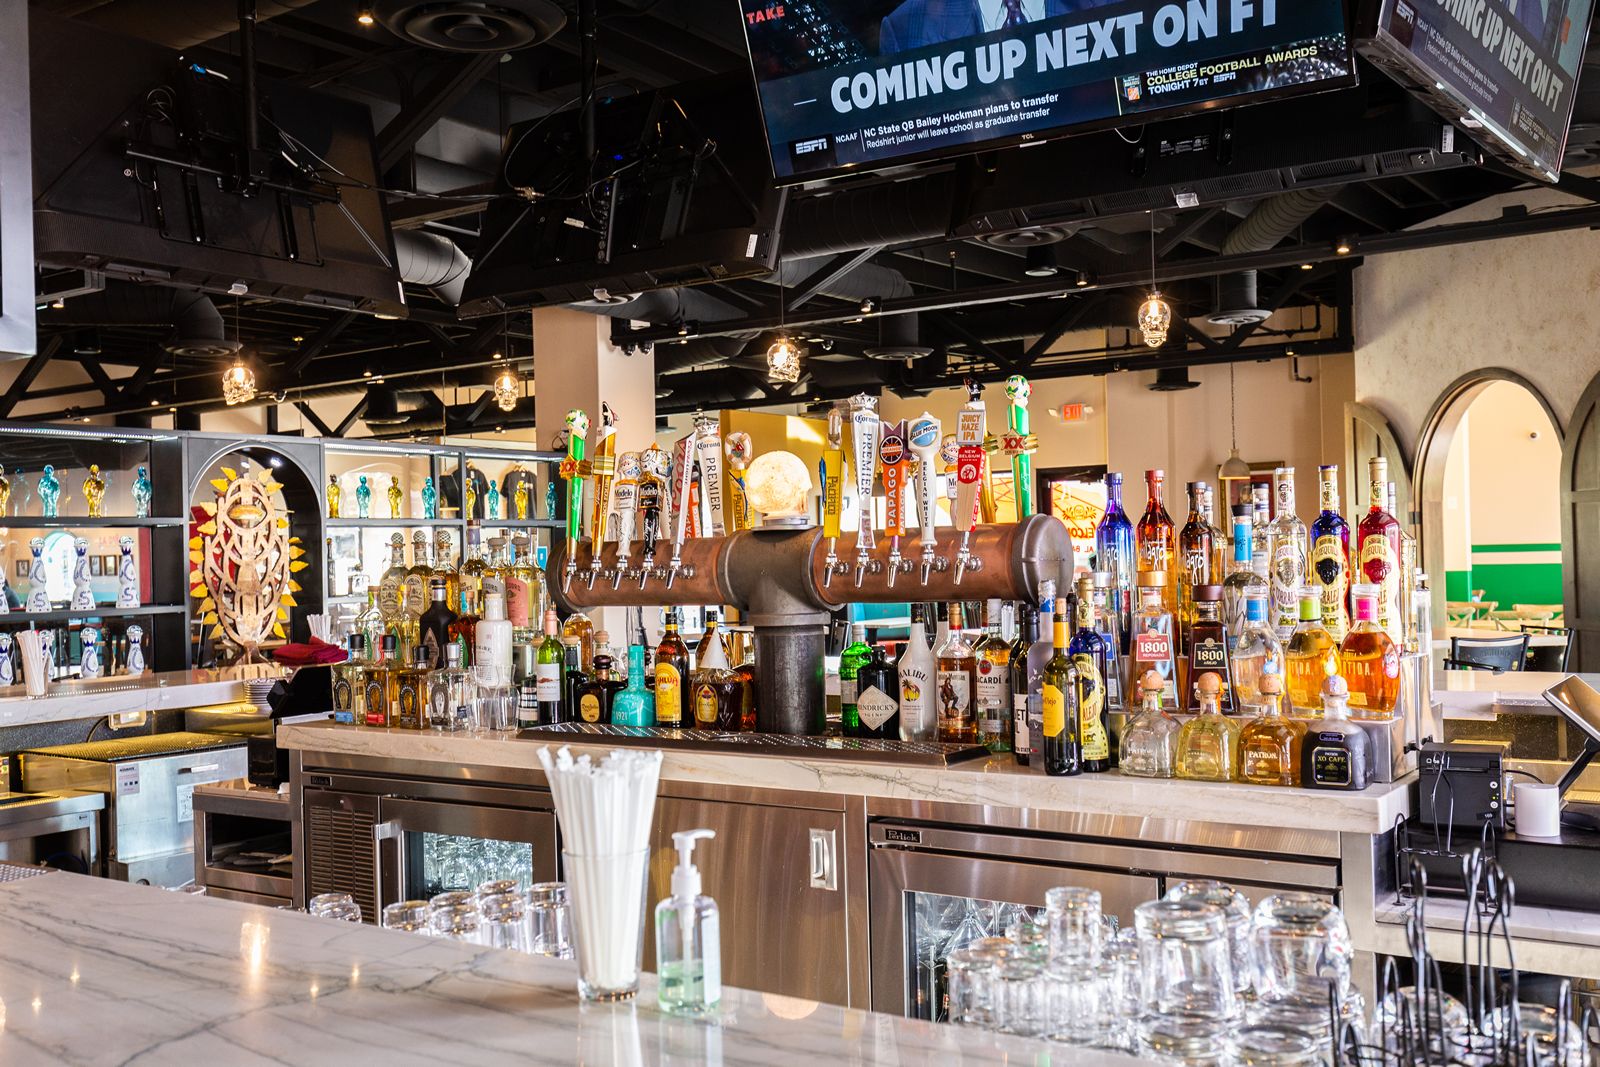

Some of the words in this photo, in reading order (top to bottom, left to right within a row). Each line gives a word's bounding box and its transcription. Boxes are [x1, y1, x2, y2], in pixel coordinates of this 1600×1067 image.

[746, 5, 785, 25] TAKE
[830, 50, 968, 114] COMING
[976, 39, 1027, 84] UP
[1035, 11, 1144, 73] NEXT
[1152, 0, 1218, 47] ON
[1481, 7, 1504, 53] UP
[1499, 26, 1535, 85] NEXT
[1530, 58, 1551, 101] ON
[1546, 73, 1564, 113] FT
[1146, 69, 1158, 77] THE
[1159, 66, 1176, 75] HOME
[1176, 62, 1198, 72] DEPOT
[1147, 69, 1198, 87] COLLEGE
[1200, 57, 1261, 77] FOOTBALL
[1264, 46, 1318, 64] AWARDS
[1148, 79, 1191, 95] TONIGHT
[1213, 72, 1236, 84] ESPN
[864, 127, 878, 138] NC
[878, 124, 901, 136] State
[902, 119, 915, 131] QB
[916, 114, 941, 128] Bailey
[943, 108, 984, 123] Hockman
[985, 103, 1009, 116] plans
[1010, 101, 1021, 110] to
[1022, 93, 1059, 108] transfer
[866, 135, 896, 149] Redshirt
[896, 132, 916, 146] junior
[917, 129, 929, 141] will
[930, 127, 949, 138] leave
[949, 121, 973, 134] school
[974, 121, 984, 129] as
[984, 113, 1019, 129] graduate
[1019, 107, 1050, 121] transfer
[796, 137, 827, 154] ESPN
[835, 131, 858, 144] NCAAF
[961, 415, 981, 423] JUICY
[1064, 404, 1082, 420] EXIT
[923, 425, 938, 434] MOON
[961, 422, 980, 431] HAZE
[963, 431, 976, 440] IPA
[1003, 437, 1025, 449] XX
[860, 432, 872, 496] PREMIER
[706, 457, 720, 512] PREMIER
[887, 468, 897, 527] PAPAGO
[1140, 641, 1168, 653] 1800
[1197, 650, 1223, 661] 1800
[888, 830, 918, 841] Perlick
